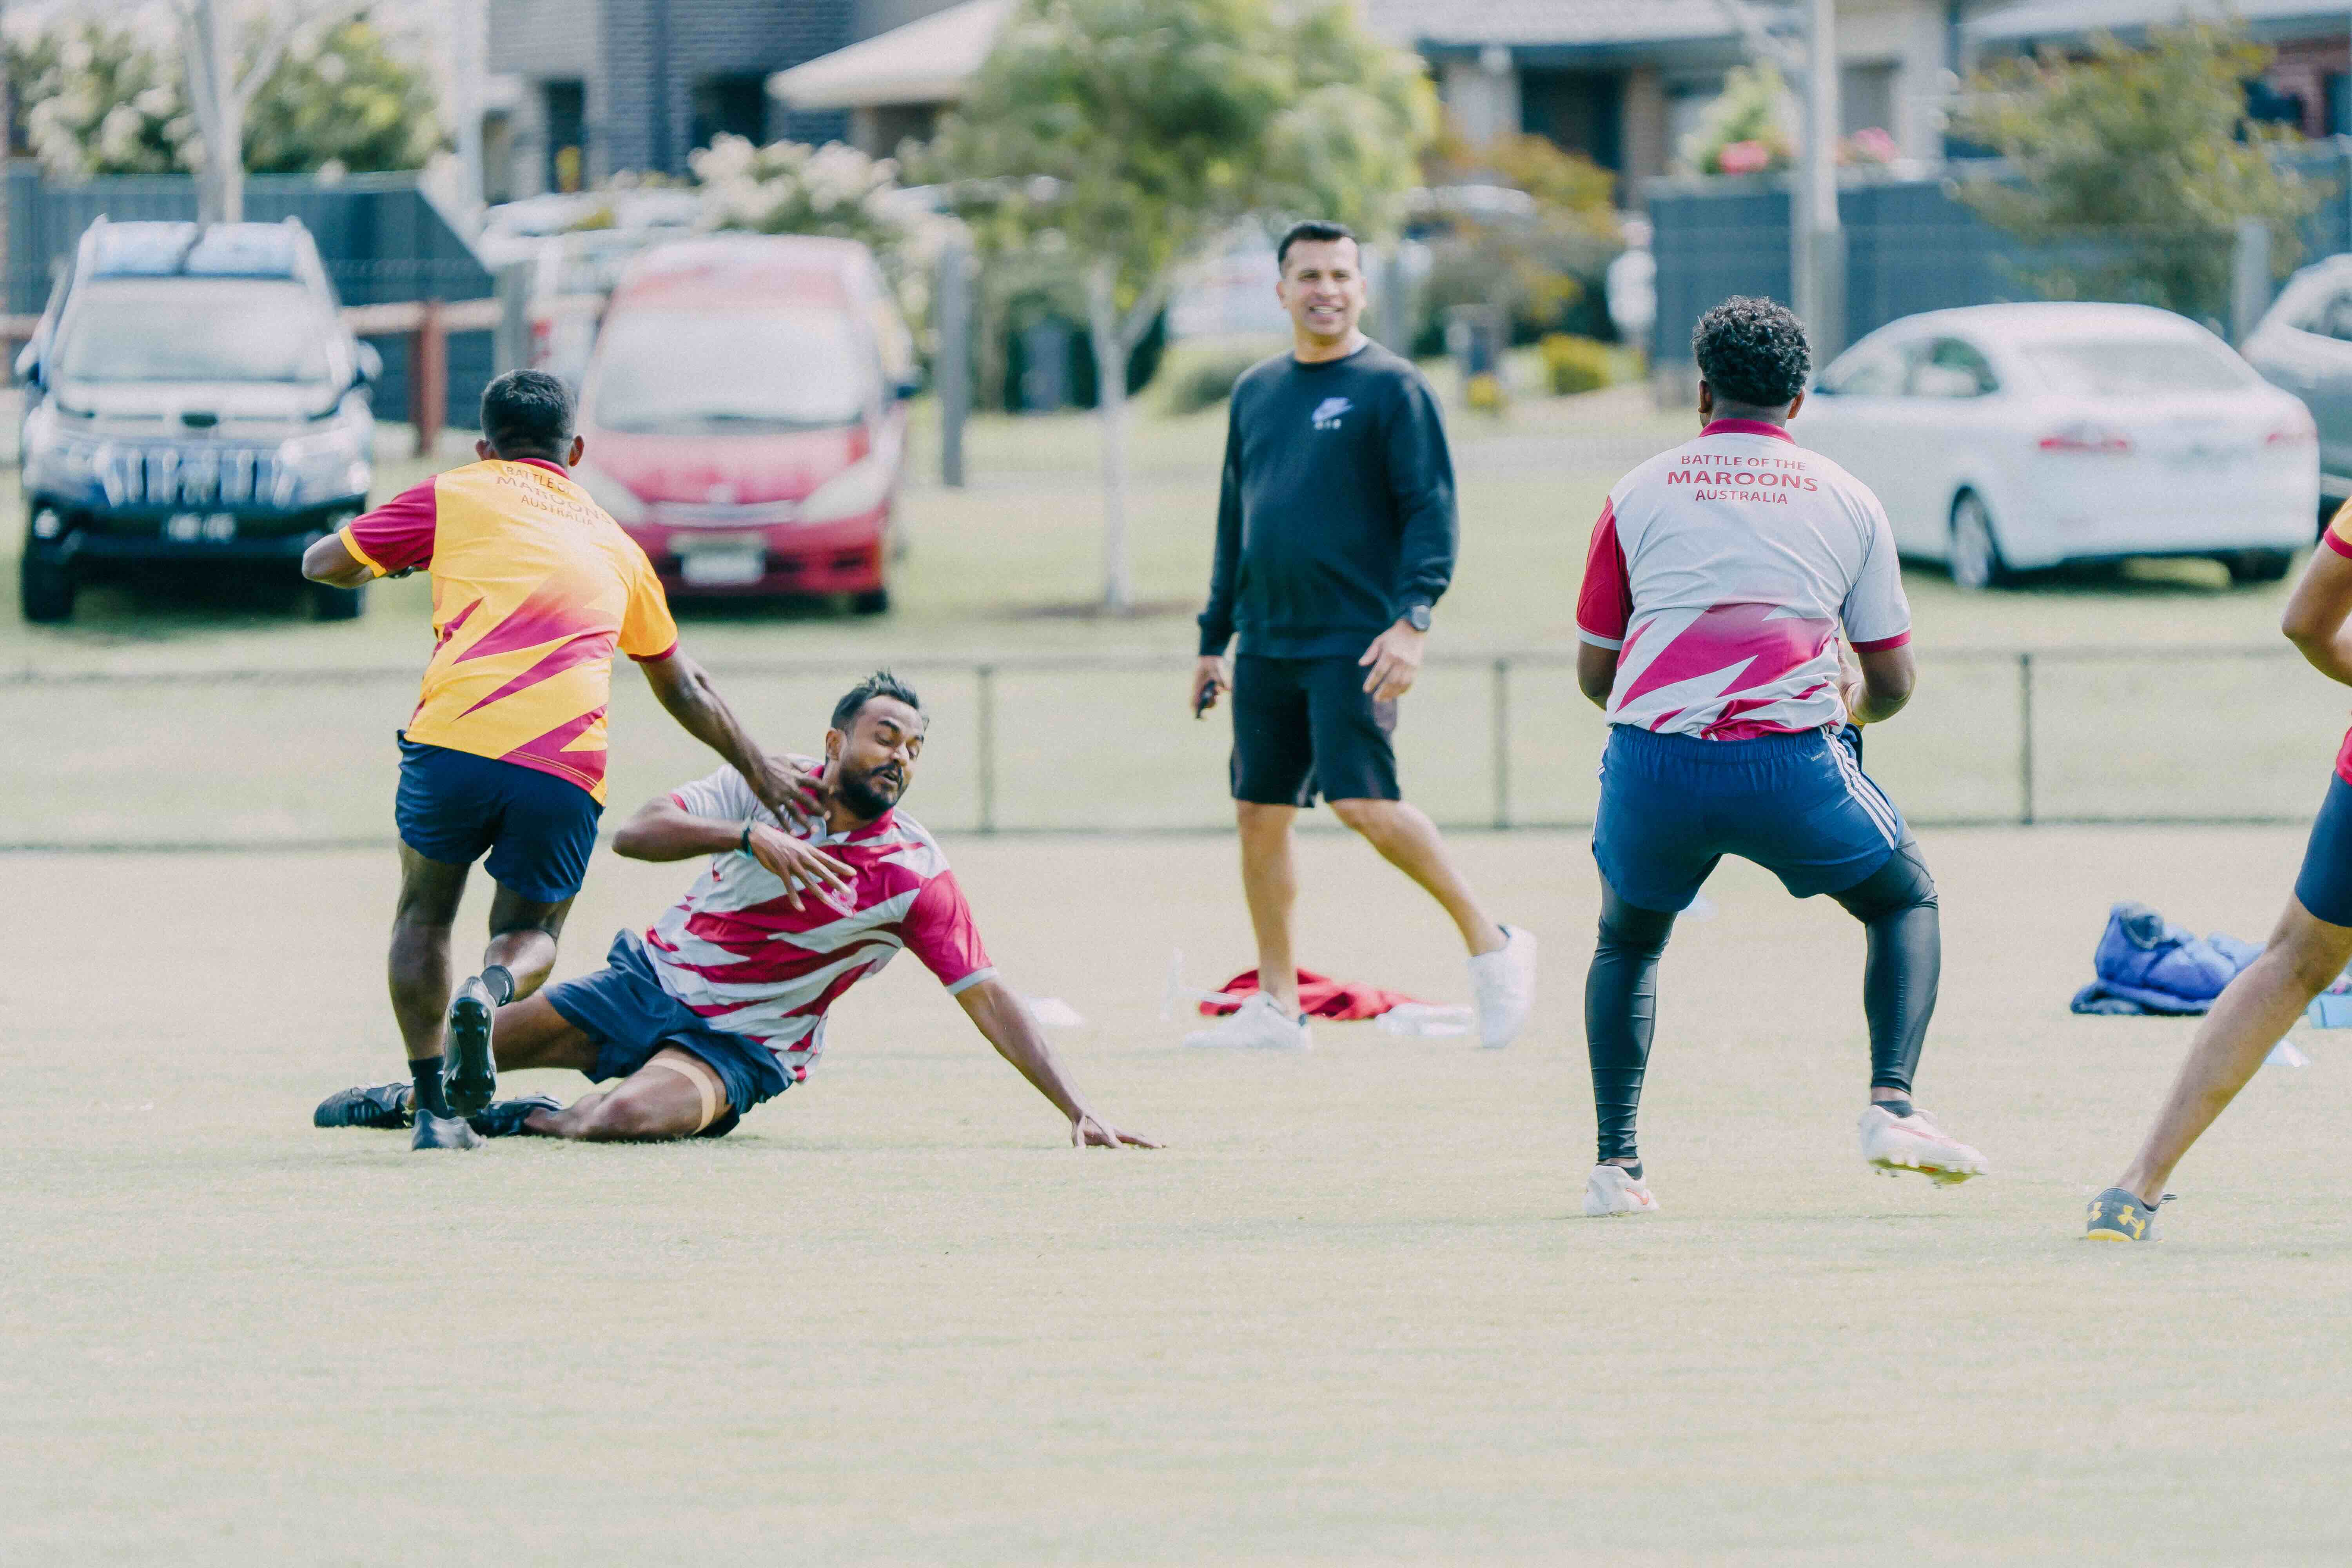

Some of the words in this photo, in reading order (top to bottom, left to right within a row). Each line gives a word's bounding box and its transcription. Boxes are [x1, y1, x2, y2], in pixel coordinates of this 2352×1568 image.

[1681, 454, 1742, 466] BATTLE
[1747, 457, 1769, 467] OF
[1773, 458, 1806, 471] THE
[506, 466, 554, 488] BATTLE
[1668, 470, 1818, 492] MAROONS
[1695, 489, 1788, 505] AUSTRALIA
